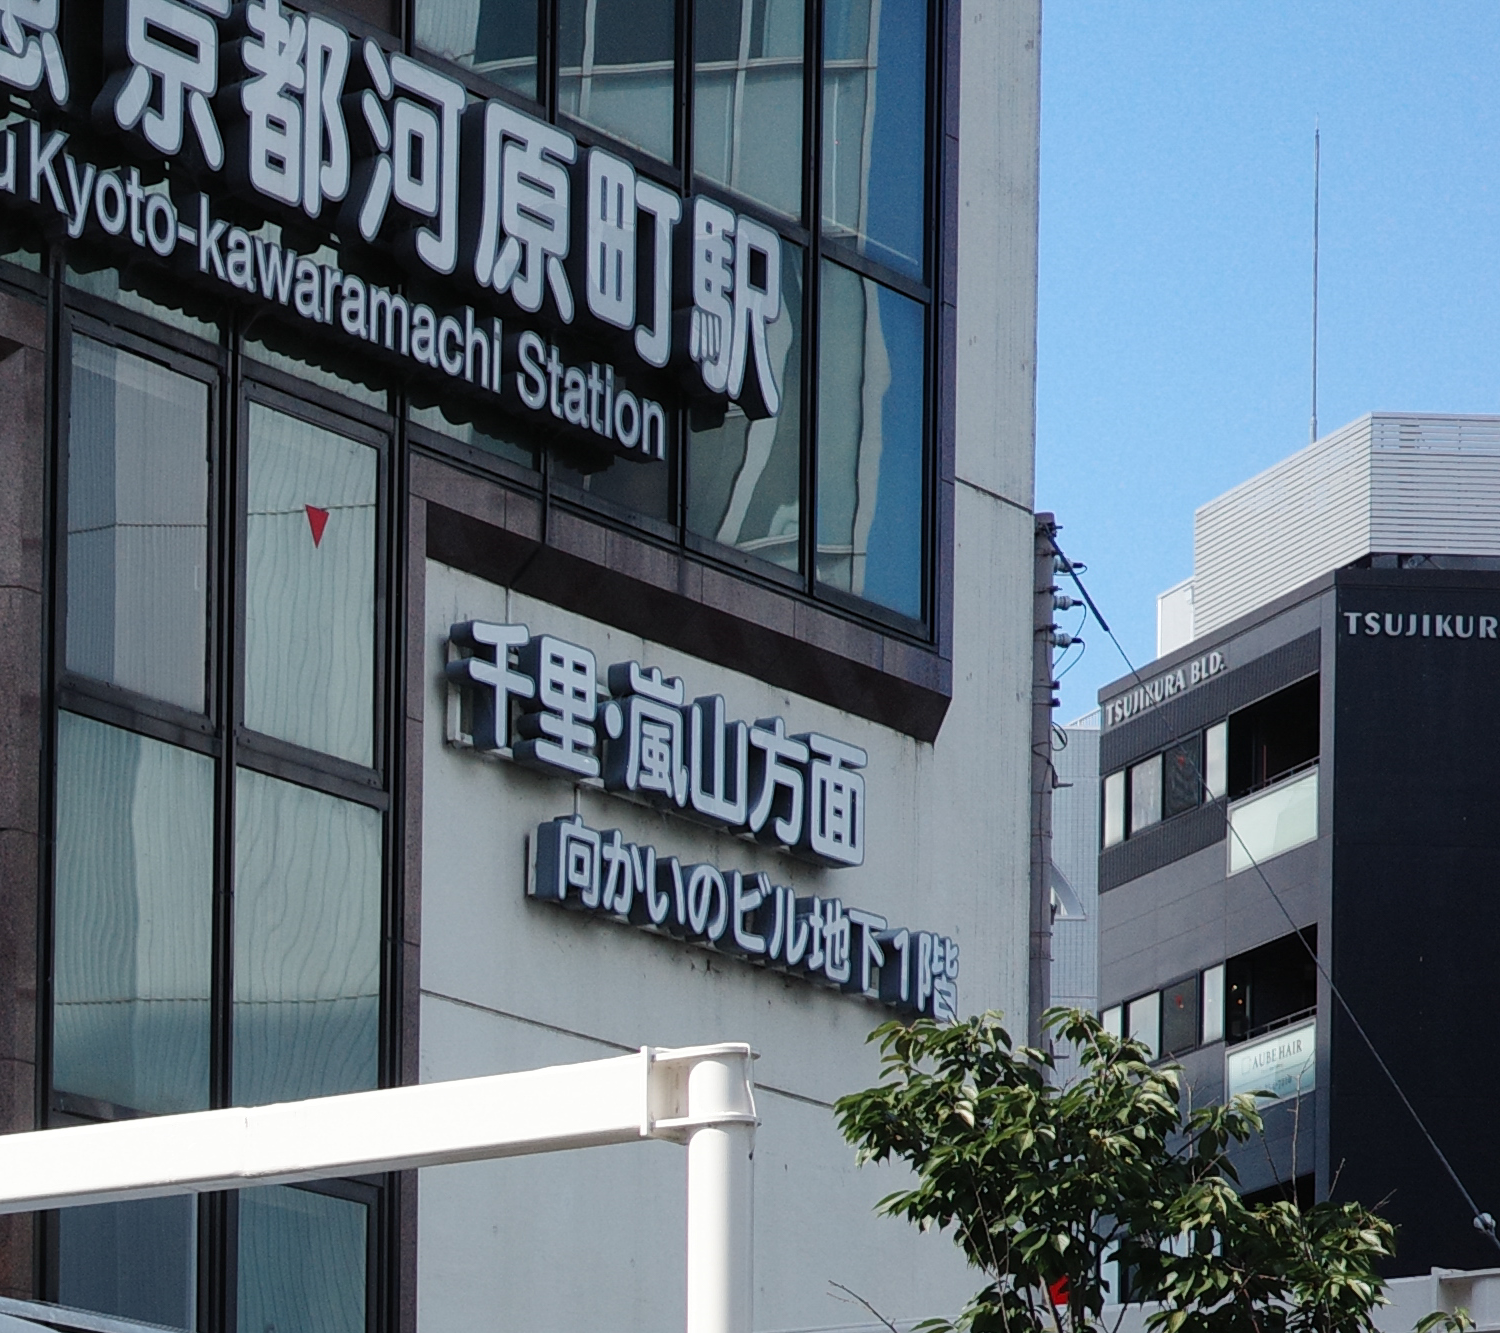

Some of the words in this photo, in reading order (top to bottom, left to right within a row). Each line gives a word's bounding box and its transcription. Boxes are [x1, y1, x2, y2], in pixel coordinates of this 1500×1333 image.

[29, 120, 502, 395] Kyoto-kawaramachi
[517, 329, 666, 461] Station
[468, 620, 869, 867] 千里・嵐山方面
[1105, 668, 1185, 727] TSUJIKURA
[1190, 650, 1228, 686] BLD.
[1253, 1048, 1277, 1070] AUBE
[1279, 1039, 1303, 1060] HAIR
